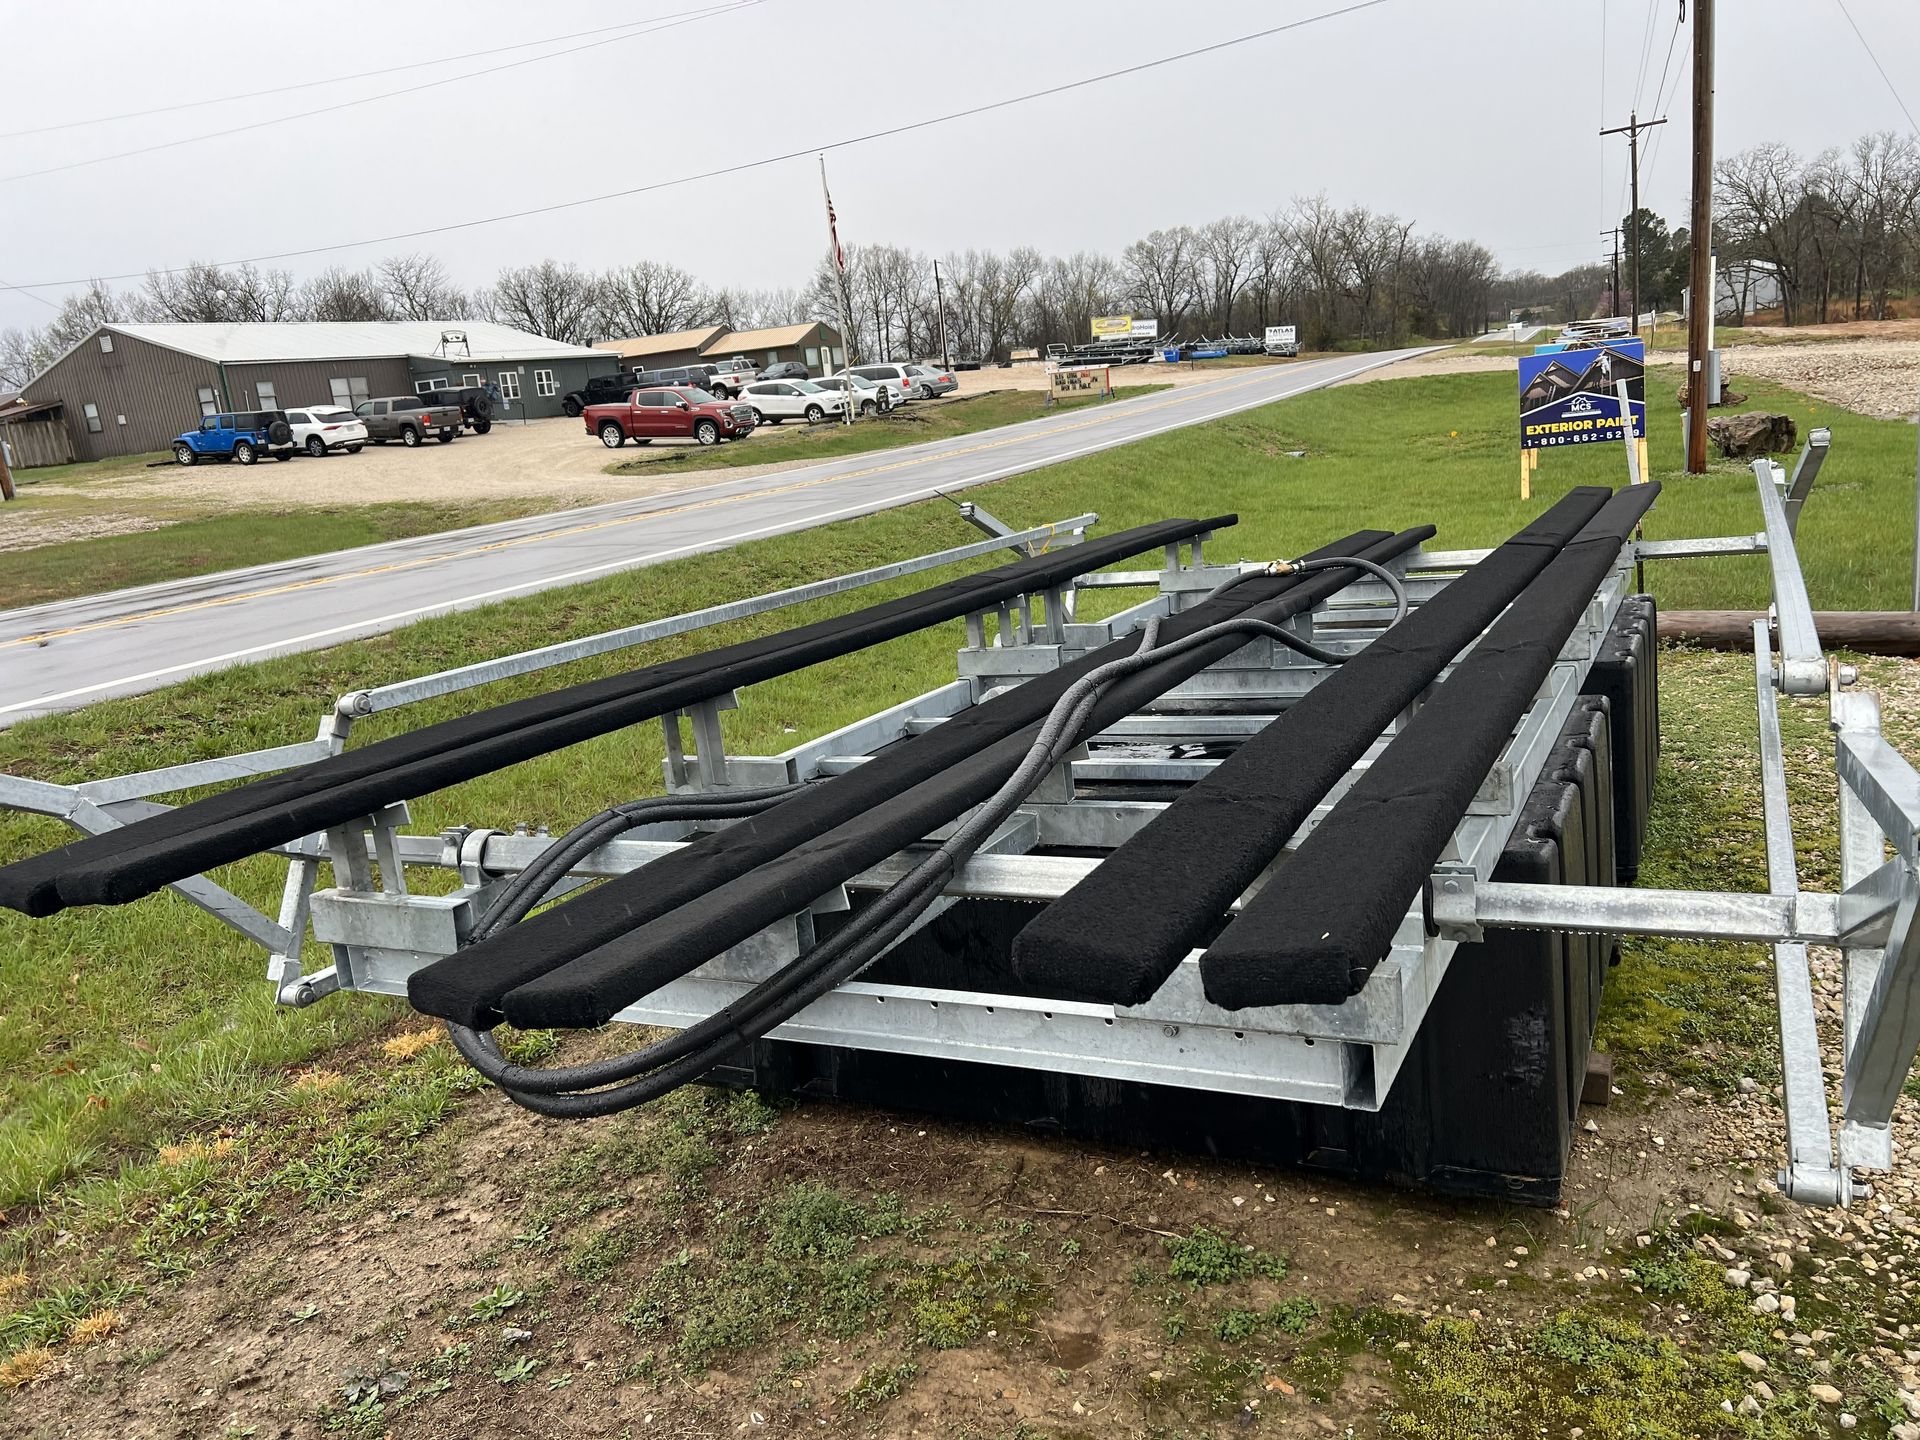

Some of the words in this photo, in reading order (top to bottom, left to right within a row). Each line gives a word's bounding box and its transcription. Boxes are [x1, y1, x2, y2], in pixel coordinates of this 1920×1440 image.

[1571, 403, 1592, 411] MCS
[1526, 420, 1593, 435] EXTERIOR
[1596, 415, 1639, 428] PAIT
[1527, 429, 1640, 447] 1-800-652-529
